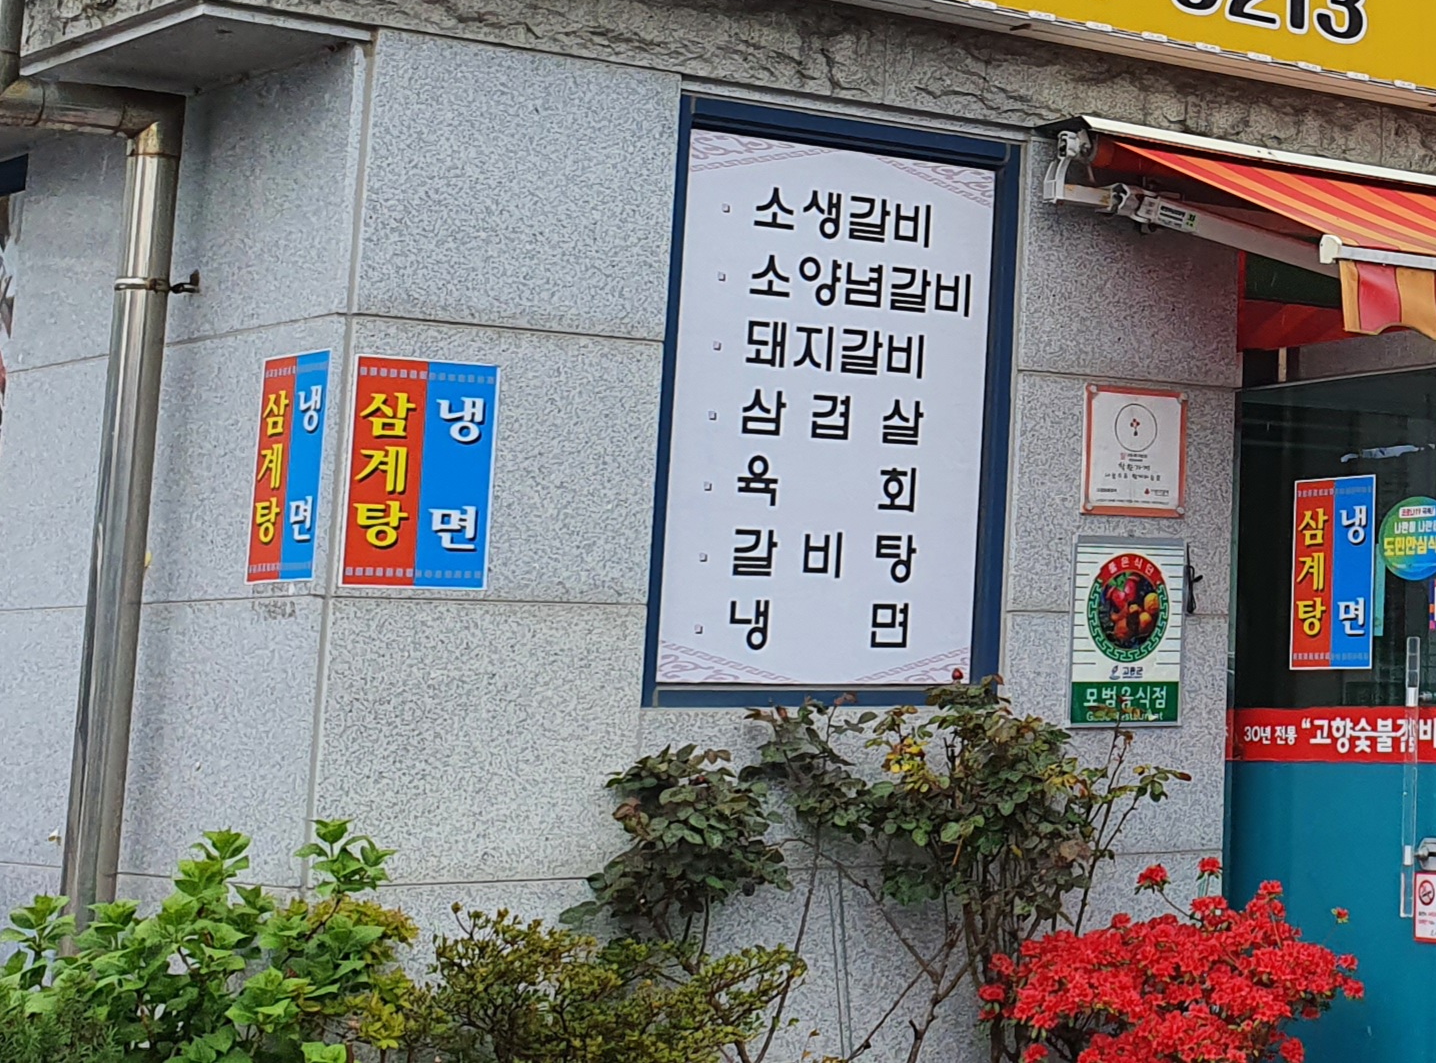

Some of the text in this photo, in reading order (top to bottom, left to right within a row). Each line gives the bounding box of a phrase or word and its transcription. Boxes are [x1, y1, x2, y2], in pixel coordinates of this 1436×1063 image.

[753, 187, 931, 248] 소생갈비
[749, 255, 971, 317] 소양념갈비
[746, 320, 924, 379] 돼지갈비
[255, 390, 289, 543] 삼계탕
[353, 392, 417, 548] 삼계탕
[1297, 508, 1328, 636] 삼계탕
[1083, 685, 1167, 709] 모범음식점
[1244, 726, 1271, 745] 30년
[1274, 726, 1297, 746] 전통
